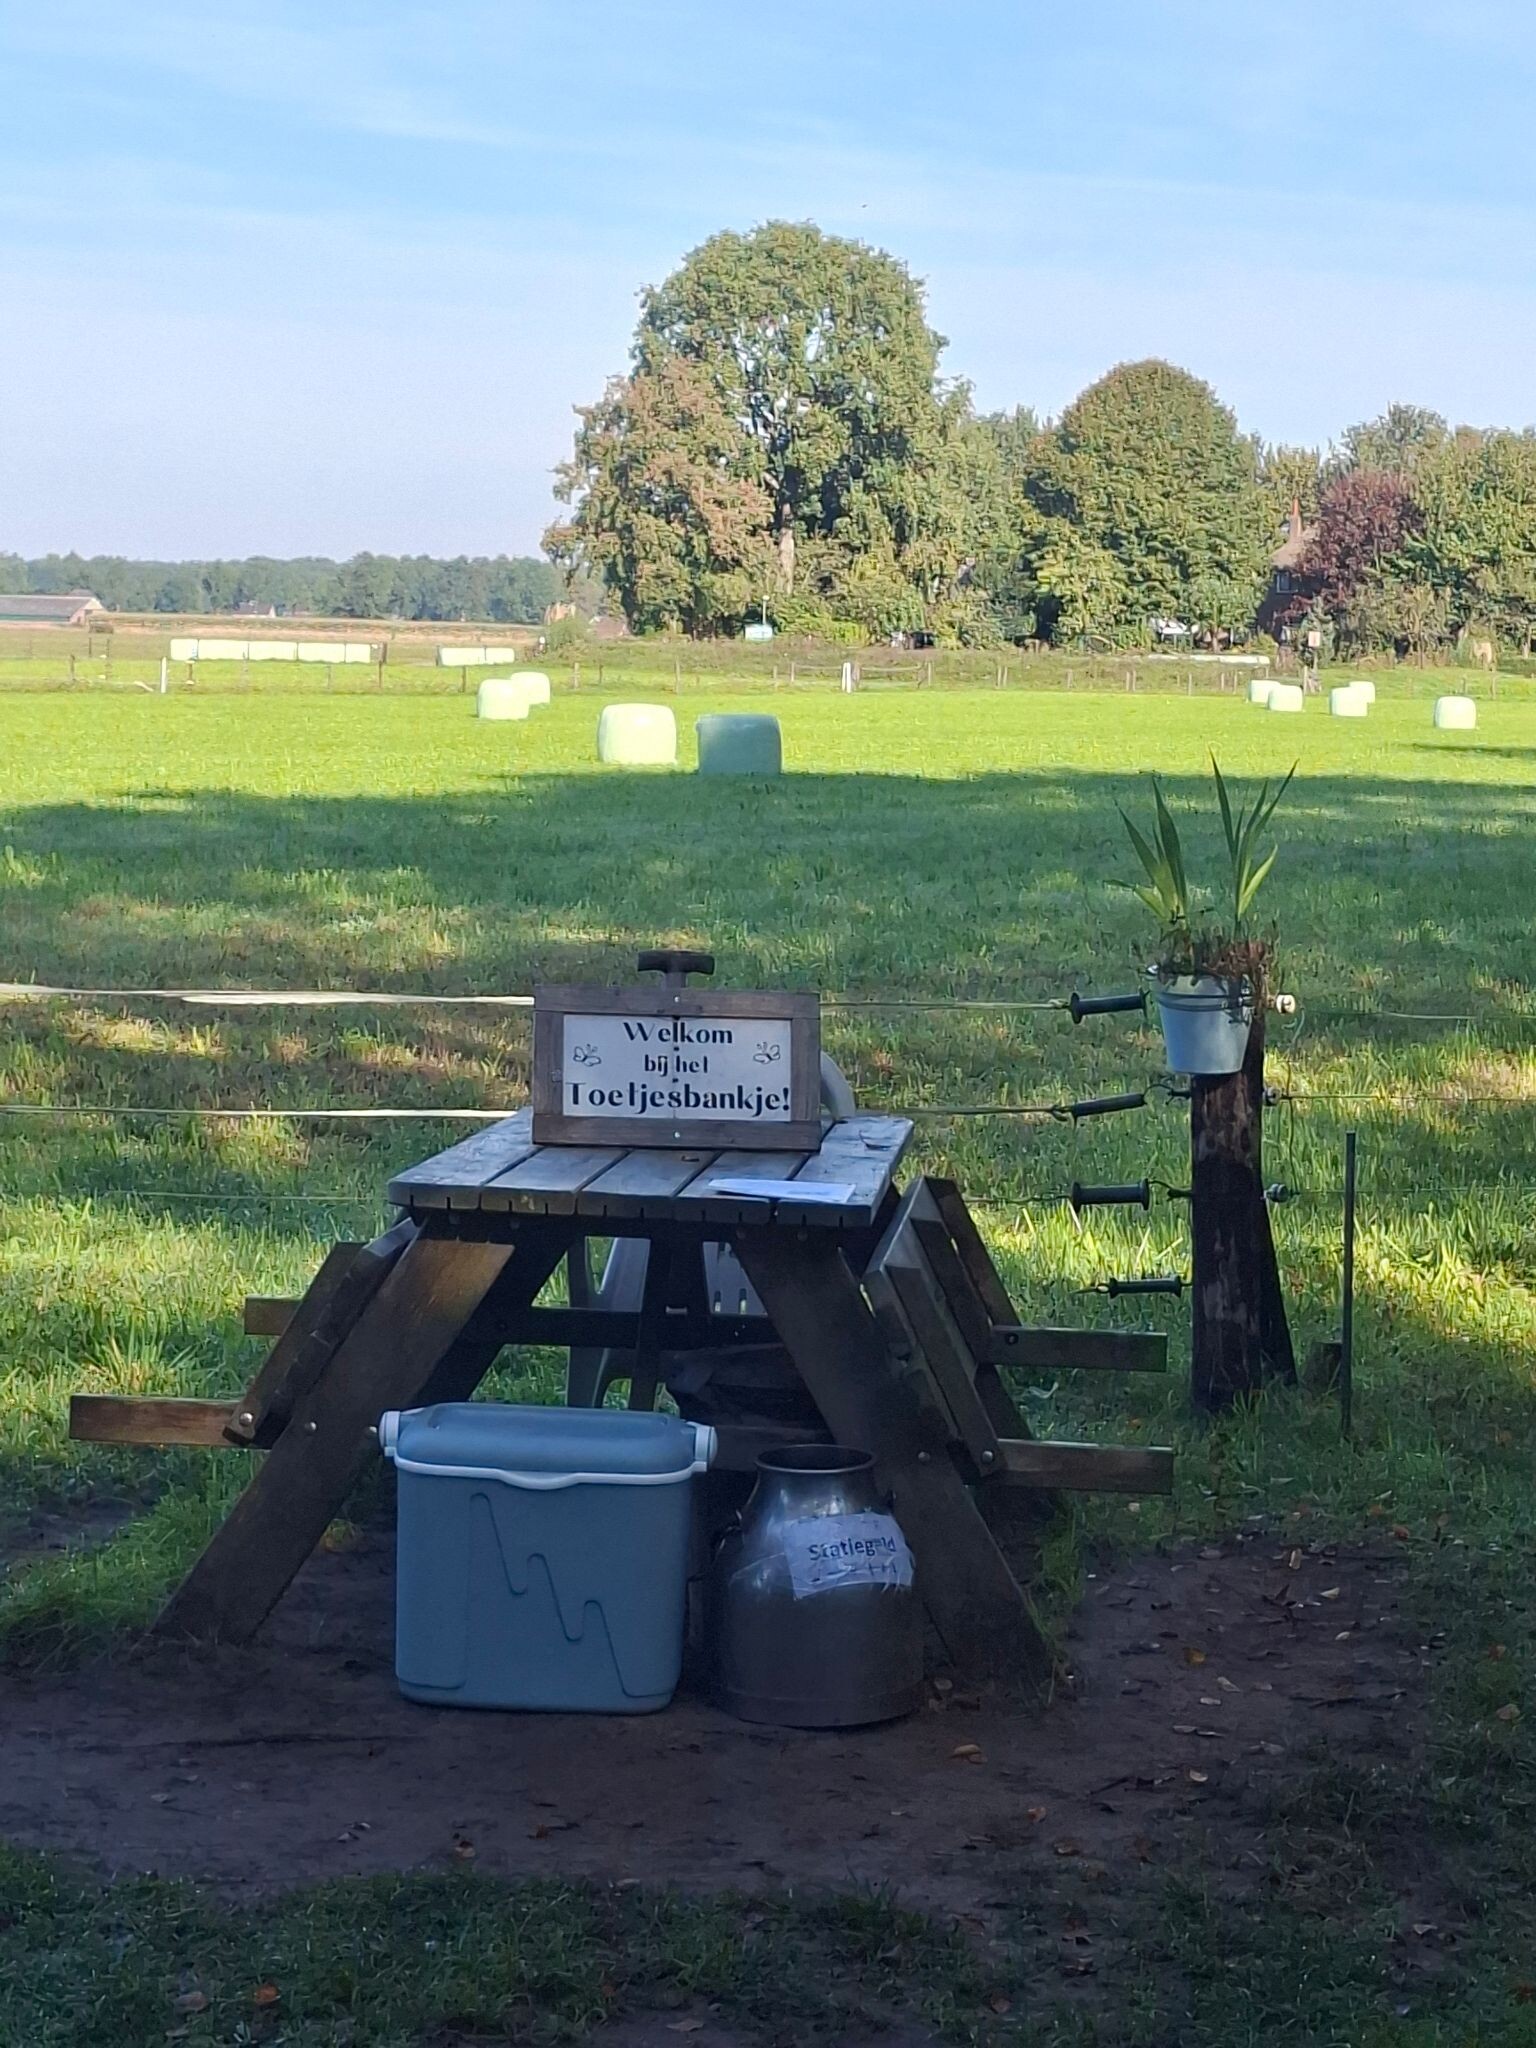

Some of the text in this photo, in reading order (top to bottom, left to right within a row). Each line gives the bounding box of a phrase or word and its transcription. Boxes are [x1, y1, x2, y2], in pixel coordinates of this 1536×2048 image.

[623, 1021, 733, 1044] Welkom
[644, 1054, 708, 1076] bij het
[566, 1082, 791, 1117] Toetjesbankje!
